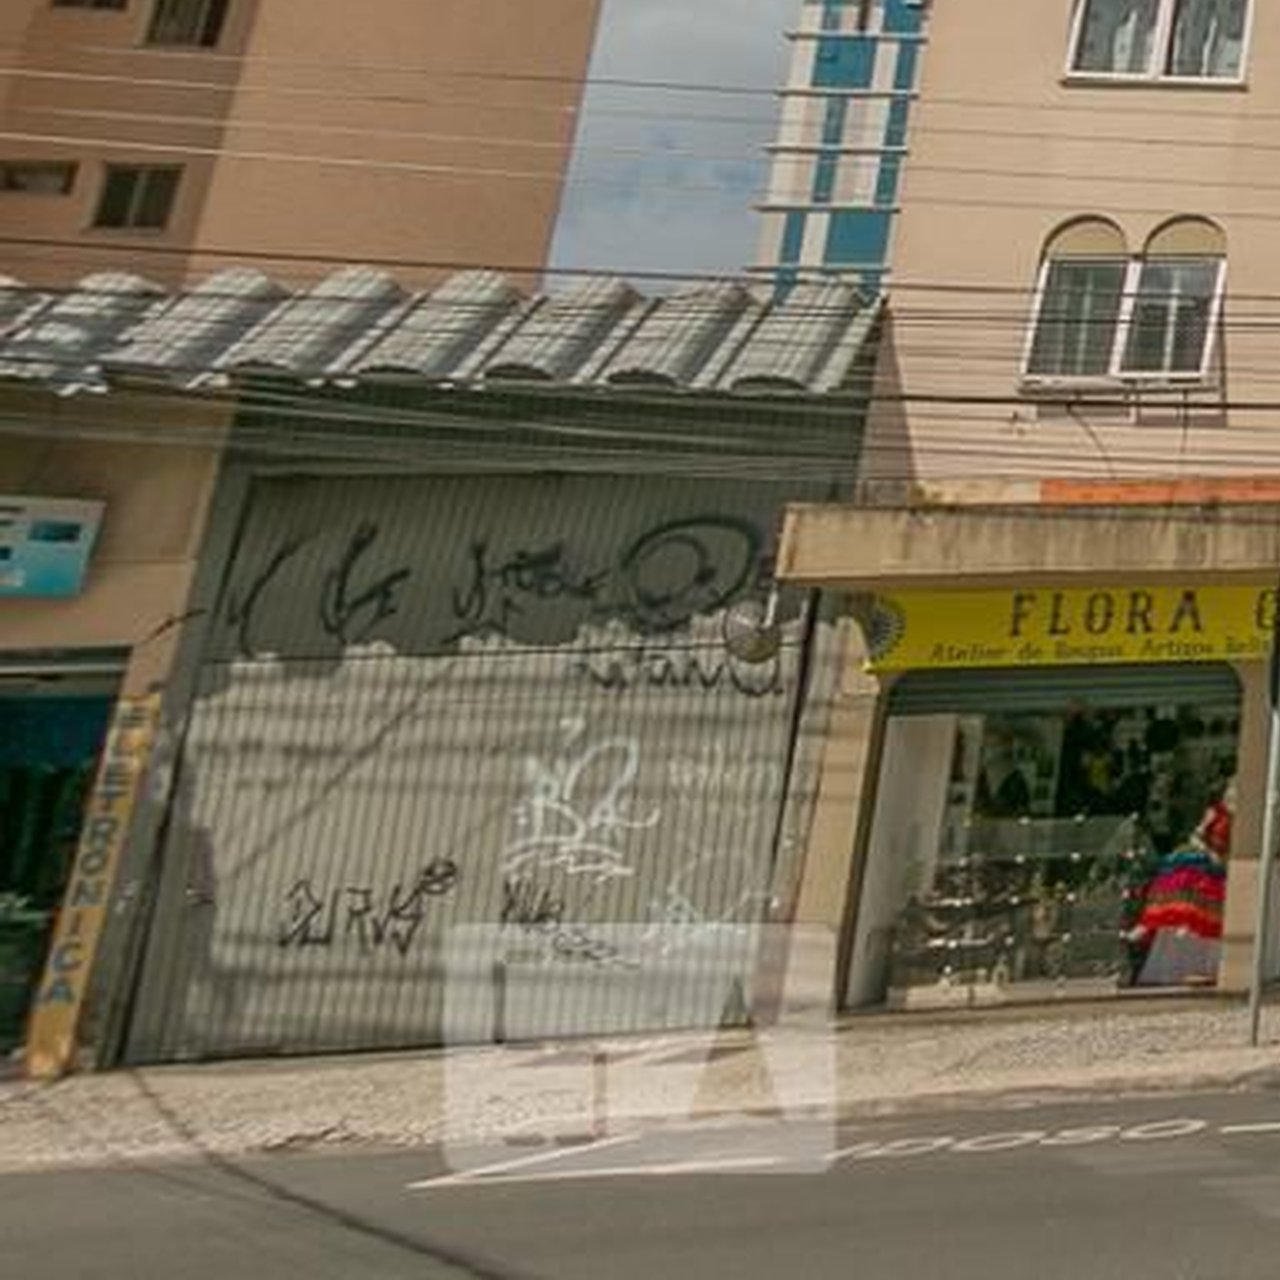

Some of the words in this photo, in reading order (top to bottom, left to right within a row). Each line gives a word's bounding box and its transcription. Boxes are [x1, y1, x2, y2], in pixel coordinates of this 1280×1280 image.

[1010, 590, 1205, 638] FLORA
[929, 642, 1008, 662] Atelier
[1018, 641, 1042, 660] de
